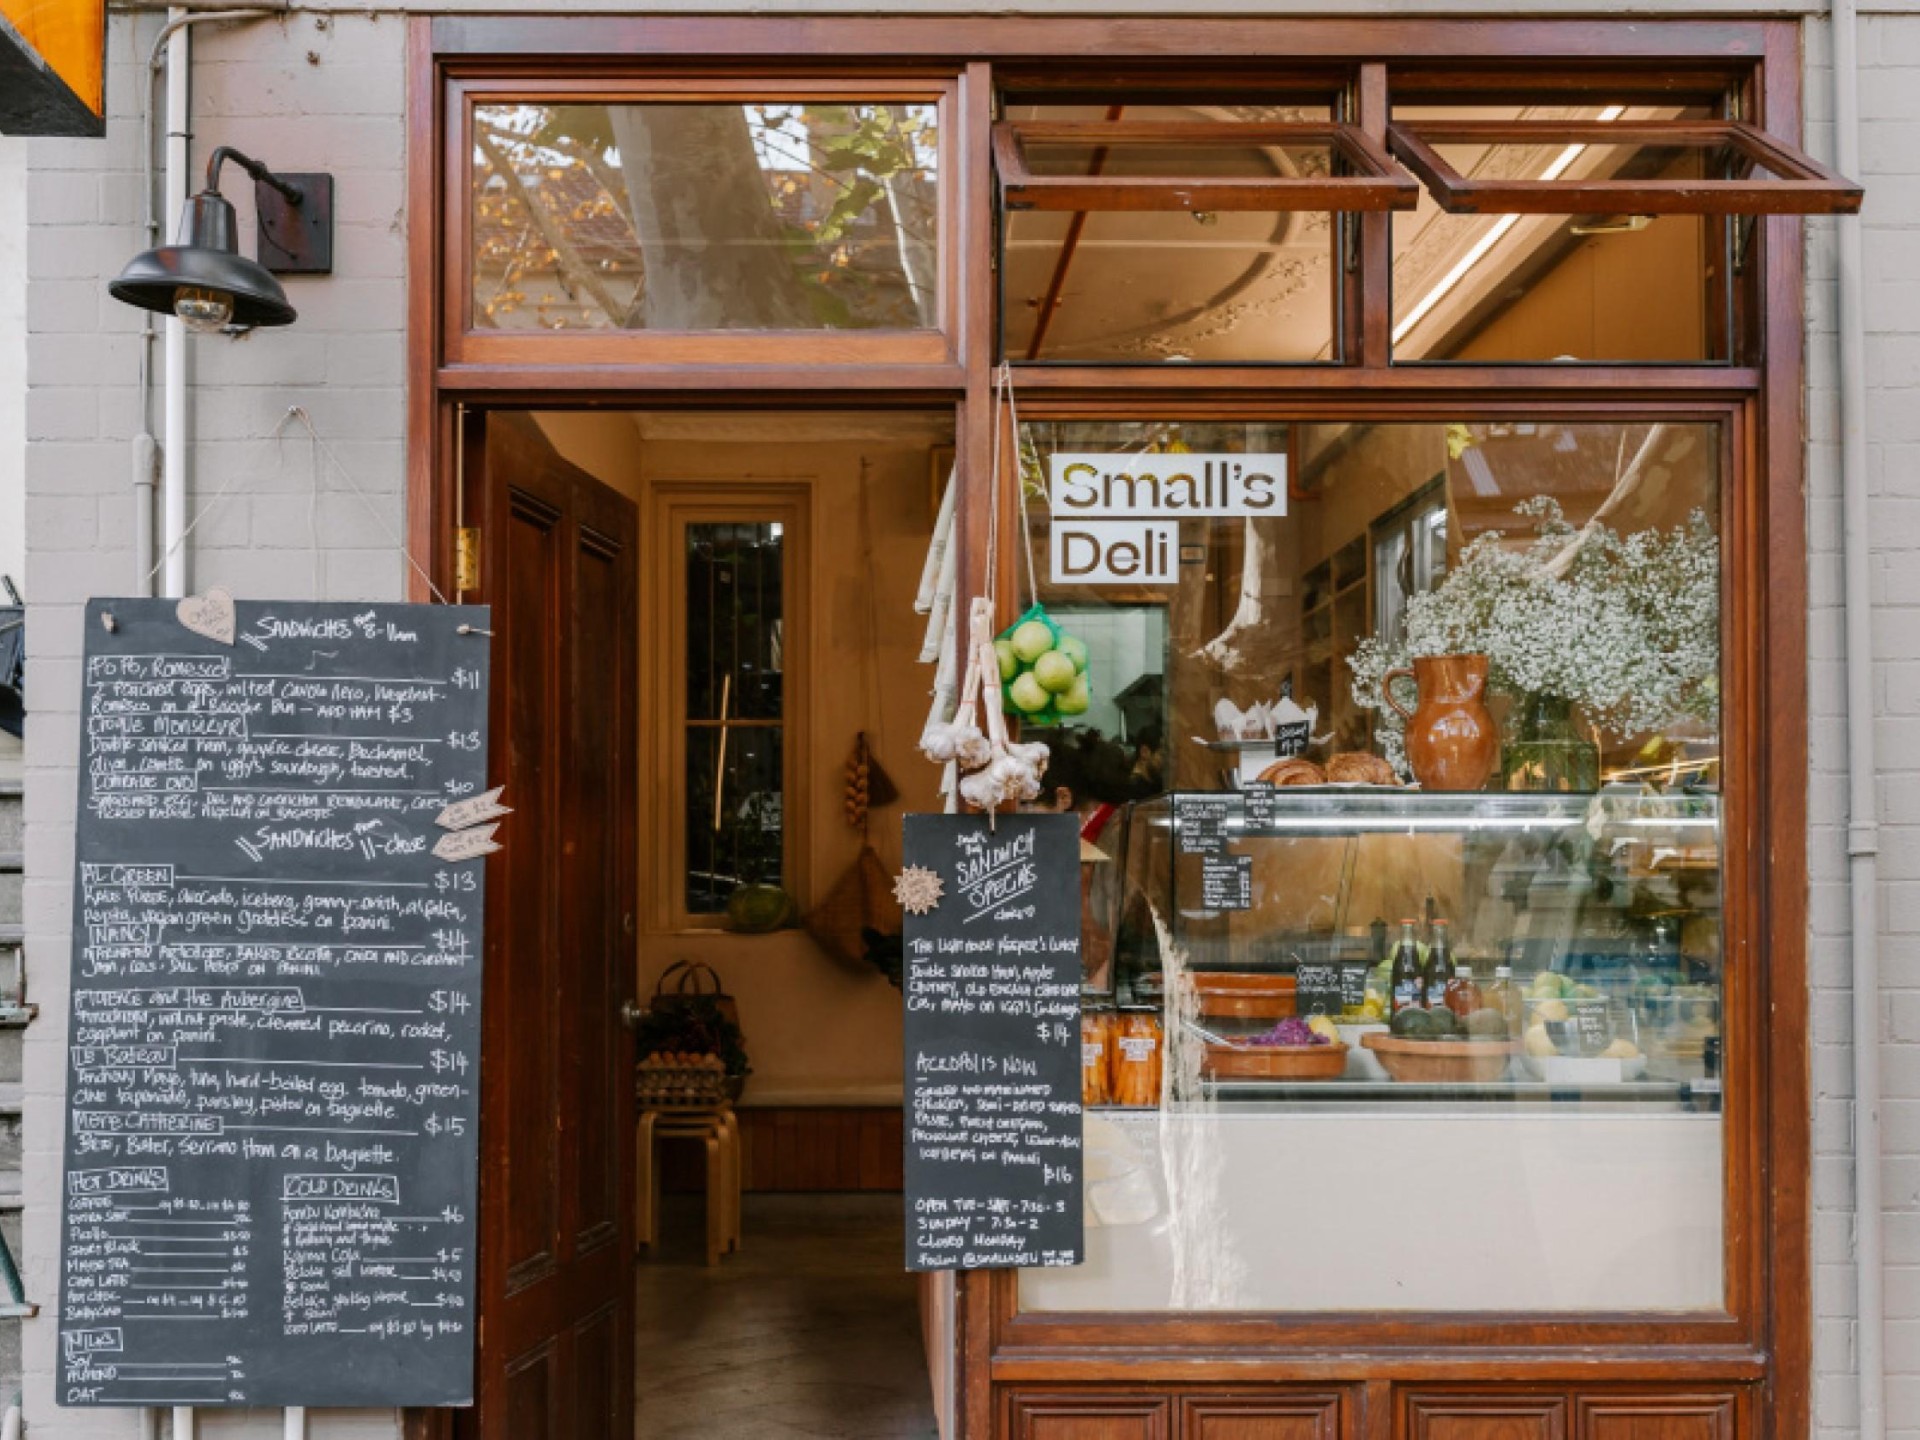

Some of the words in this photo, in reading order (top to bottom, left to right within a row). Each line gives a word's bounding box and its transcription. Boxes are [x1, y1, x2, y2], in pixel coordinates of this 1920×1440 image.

[1063, 460, 1275, 509] Small's
[1061, 528, 1168, 577] Deli
[434, 869, 477, 894] $13
[427, 988, 472, 1015] $14
[429, 1047, 470, 1075] $14
[423, 1110, 467, 1138] $15
